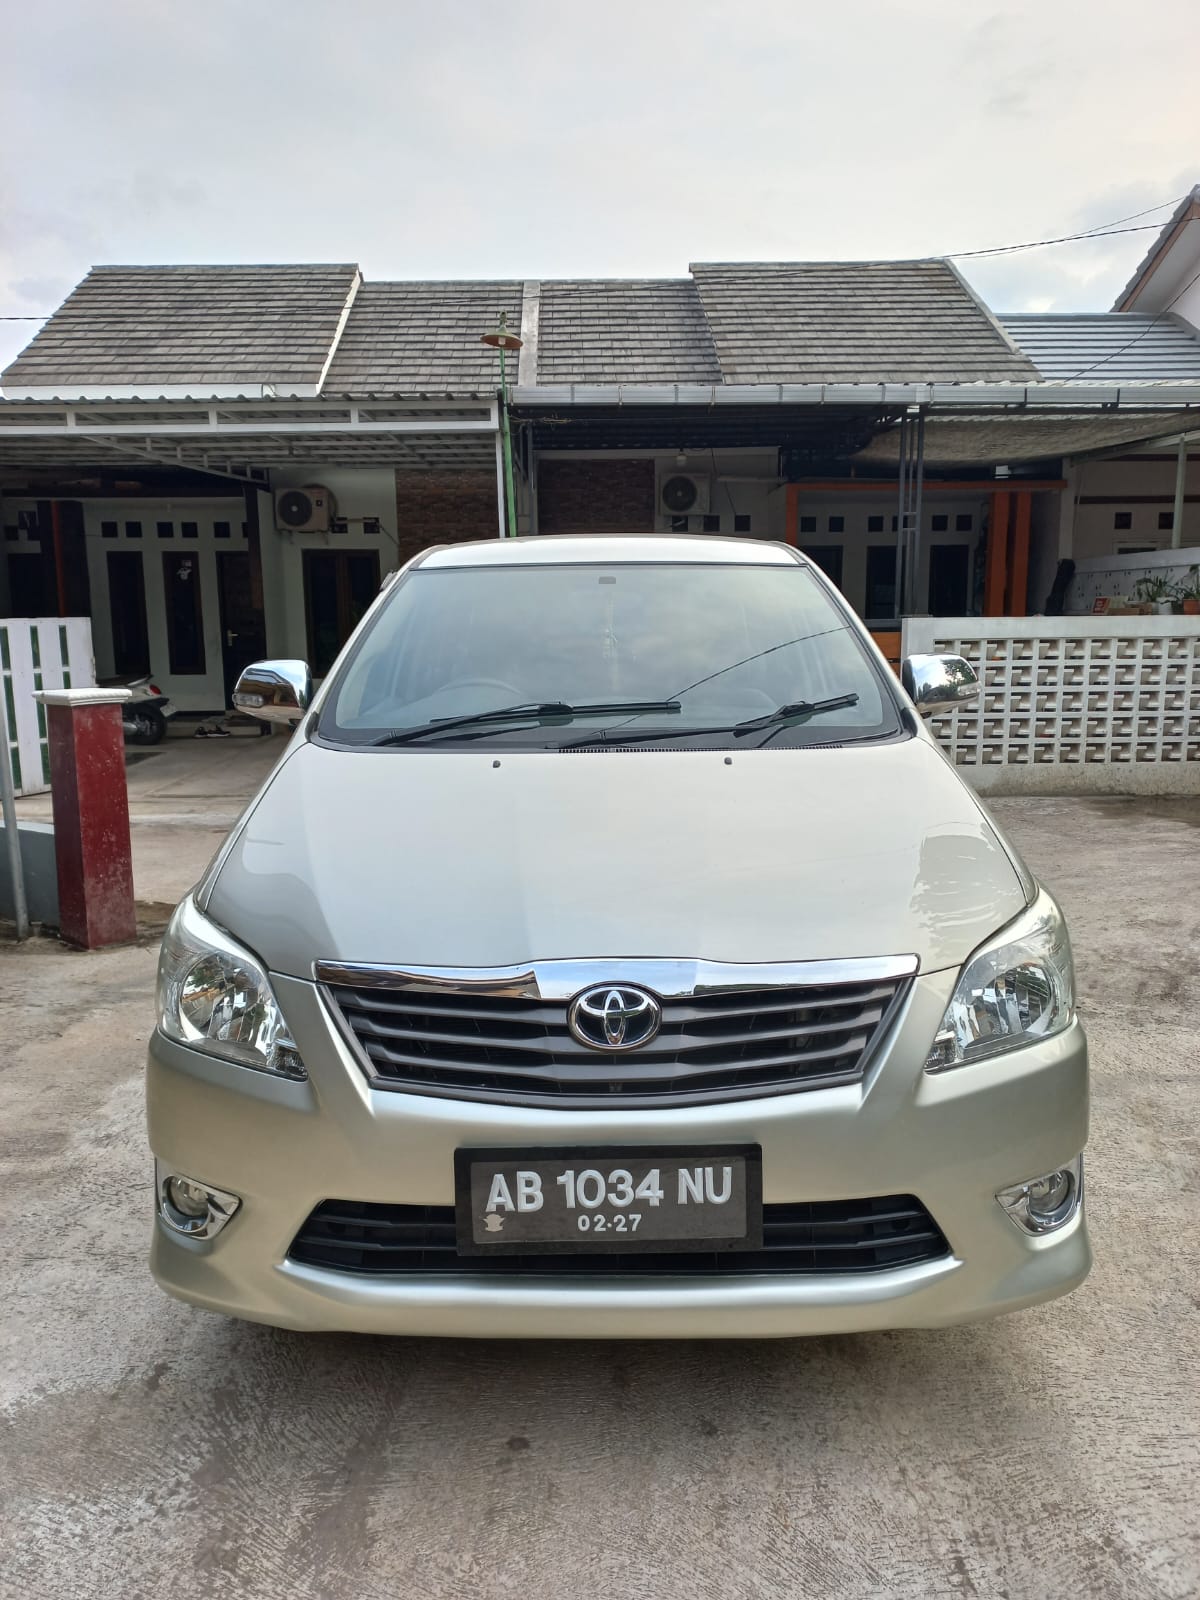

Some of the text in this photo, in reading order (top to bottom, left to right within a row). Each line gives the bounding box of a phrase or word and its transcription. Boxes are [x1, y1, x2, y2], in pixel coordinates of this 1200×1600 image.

[485, 1166, 733, 1213] AB 1034 NU
